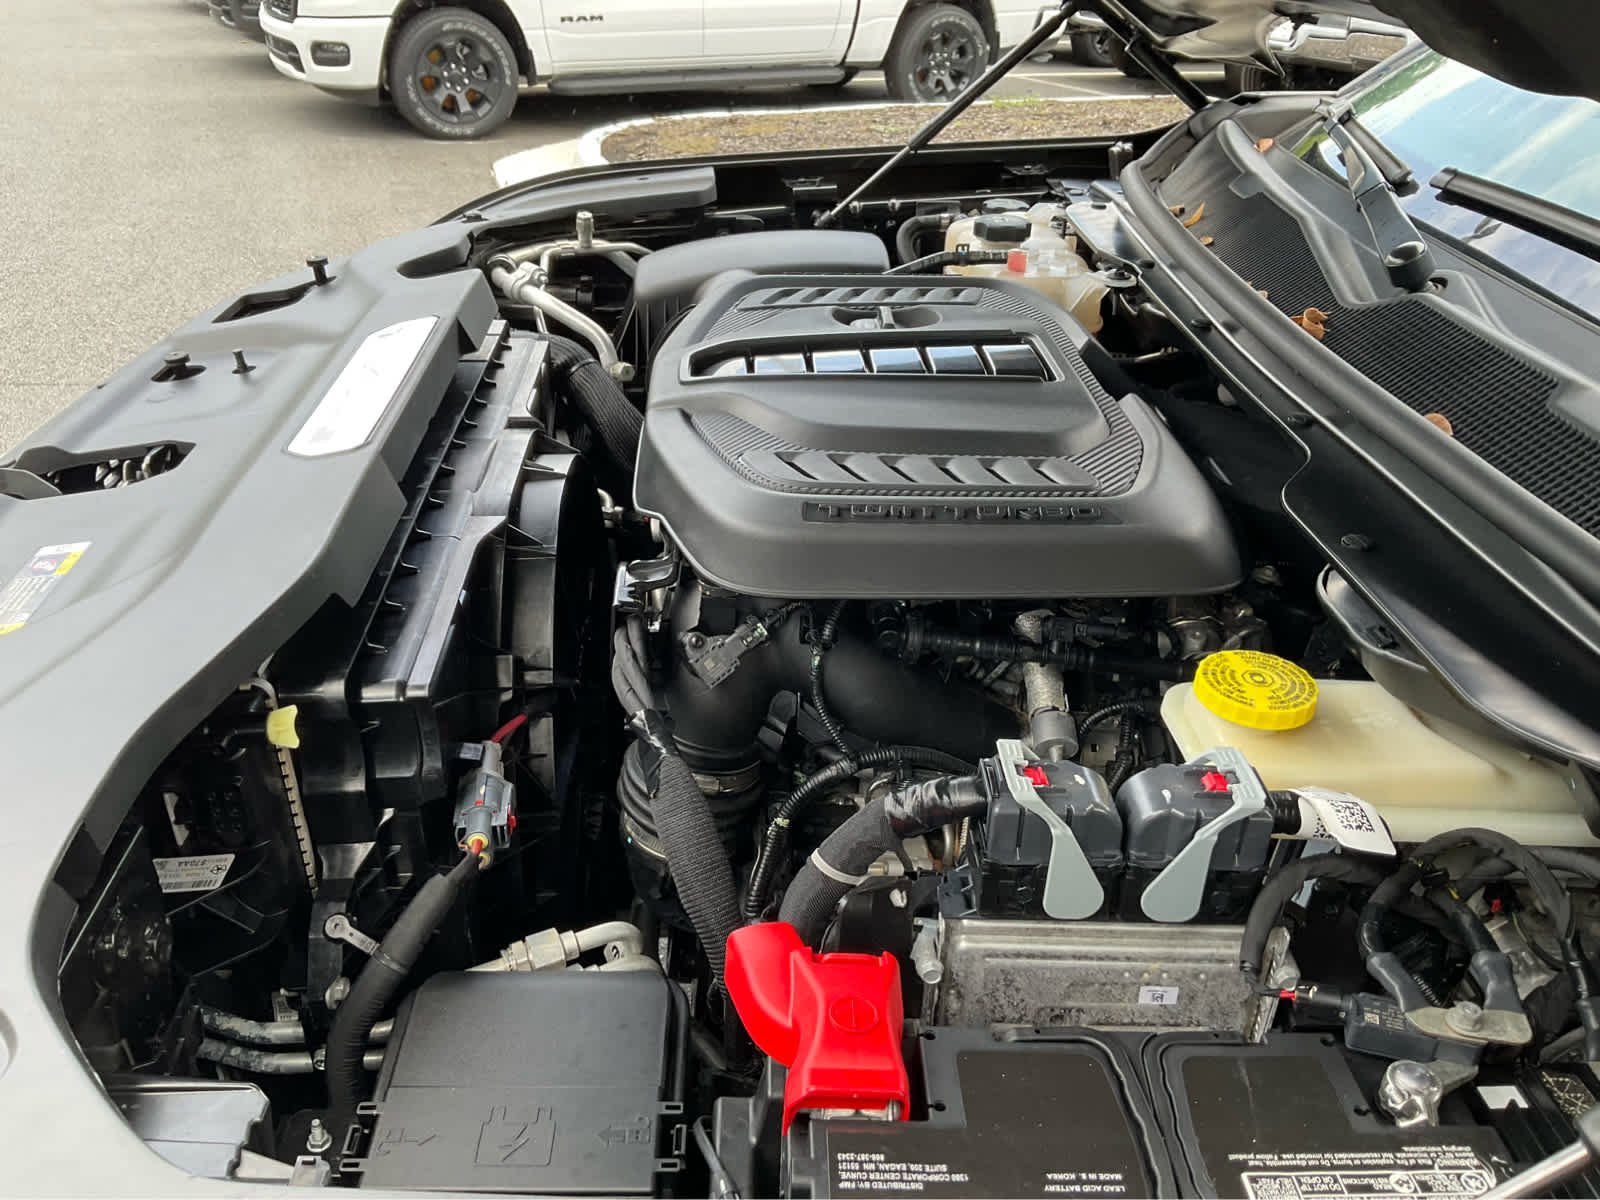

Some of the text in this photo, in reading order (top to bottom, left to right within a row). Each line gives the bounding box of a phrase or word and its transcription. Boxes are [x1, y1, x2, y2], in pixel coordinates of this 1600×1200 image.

[560, 15, 604, 23] RAM
[944, 503, 1101, 521] TURBO
[924, 1164, 948, 1172] SUITE
[838, 1171, 867, 1180] CURVE,
[869, 1172, 900, 1180] CENTER
[902, 1172, 950, 1181] CORPORATE
[838, 1181, 856, 1190] FMP
[872, 1181, 924, 1190] DISTRIBUTED
[1044, 1184, 1080, 1192] BATTERY
[1312, 1183, 1328, 1191] NOT
[1329, 1183, 1342, 1191] DO
